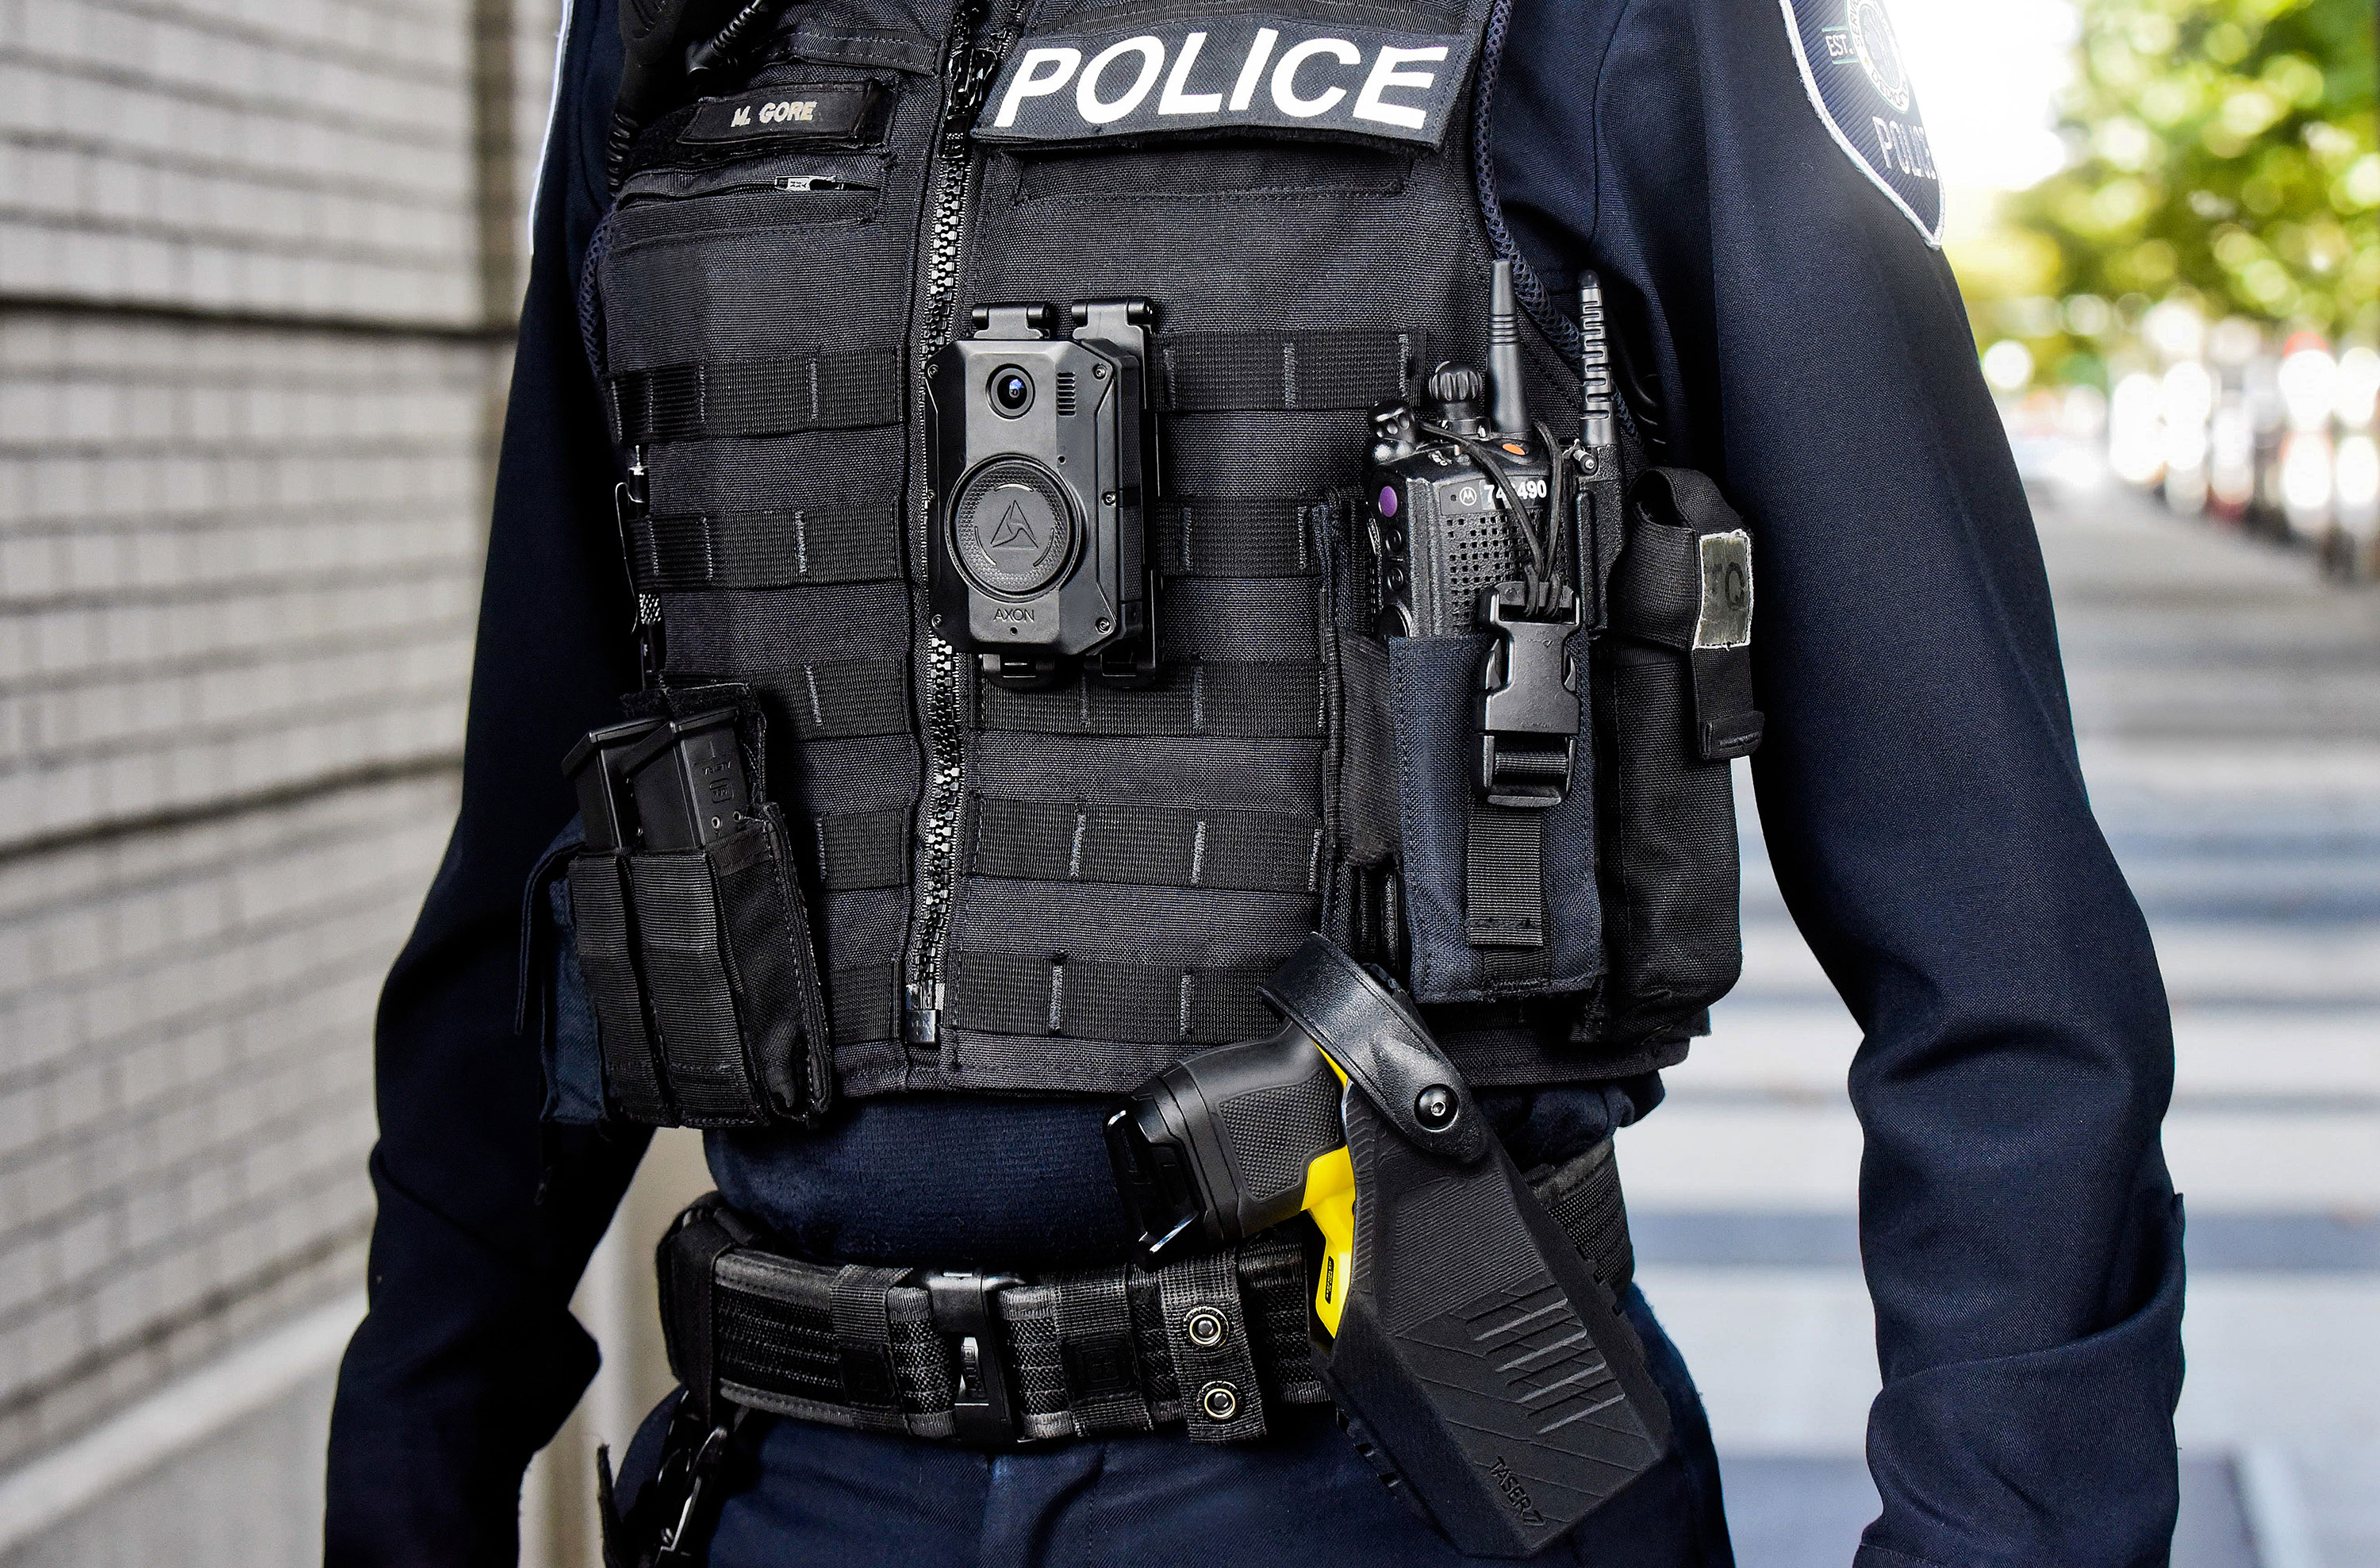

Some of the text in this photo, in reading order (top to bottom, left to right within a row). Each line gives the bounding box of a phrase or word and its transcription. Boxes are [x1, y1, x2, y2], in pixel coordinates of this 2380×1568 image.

[1825, 34, 1855, 56] EST.
[993, 27, 1449, 129] POLICE
[731, 101, 817, 127] M. GORE
[1484, 479, 1547, 502] 74490
[992, 608, 1035, 622] AXON
[1490, 1455, 1531, 1515] TASER
